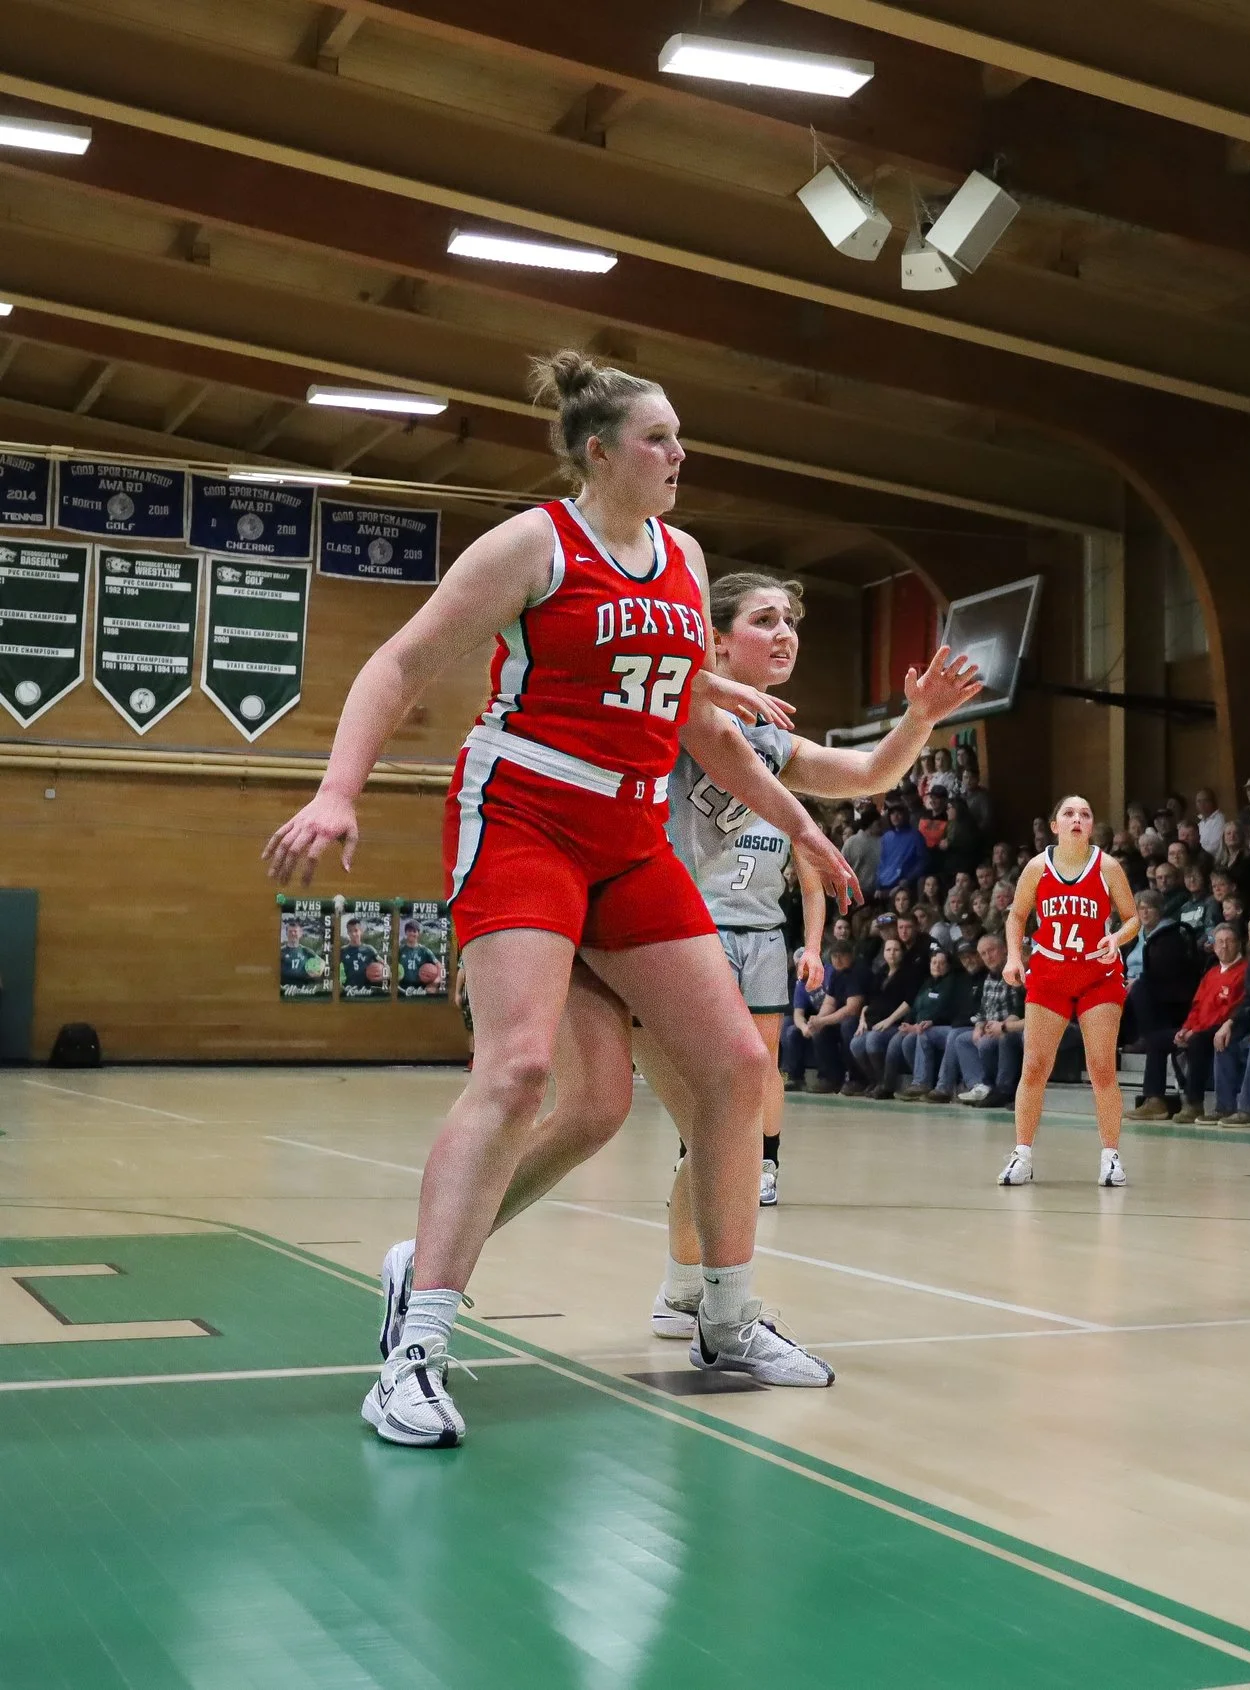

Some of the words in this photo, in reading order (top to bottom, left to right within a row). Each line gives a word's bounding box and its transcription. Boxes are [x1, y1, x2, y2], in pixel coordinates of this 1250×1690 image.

[71, 464, 95, 477] GOOD
[97, 464, 174, 489] SPORTSMANSHIP
[98, 479, 144, 493] AWARD
[6, 489, 37, 501] 2014
[203, 486, 227, 497] GOOD
[229, 485, 302, 508] SPORTSMANSHIP
[72, 497, 102, 511] NORTH
[230, 499, 274, 513] AWARD
[2, 511, 44, 523] TENNIS
[332, 510, 355, 523] GOOD
[356, 511, 427, 534] SPORTSMANSHIP
[105, 522, 136, 532] GOLF
[357, 524, 400, 538] AWARD
[225, 540, 275, 552] CHEERING
[326, 542, 353, 555] CLASS
[354, 546, 361, 556] D
[20, 556, 60, 568] BASEBALL
[22, 569, 61, 580] CHAMPIONS
[134, 566, 181, 579] WRESTLING
[358, 563, 404, 576] CHEERING
[137, 580, 174, 590] CHAMPIONS
[245, 575, 264, 586] GOLF
[247, 589, 283, 599] CHAMPIONS
[29, 612, 68, 623] CHAMPIONS
[143, 620, 181, 631] CHAMPIONS
[595, 597, 706, 651] DEXTER
[21, 646, 61, 657] CHAMPIONS
[136, 655, 174, 666] CHAMPIONS
[601, 655, 693, 721] 32
[731, 854, 756, 890] 3
[296, 900, 321, 911] PVHS
[355, 901, 380, 911] PVHS
[413, 903, 438, 913] PVHS
[1042, 895, 1098, 919] DEXTER
[1051, 921, 1085, 953] 14
[323, 915, 331, 990] SENIOR
[382, 916, 390, 990] SENIOR
[439, 917, 447, 991] SENIOR
[291, 959, 300, 969] 17
[353, 960, 359, 971] 5
[284, 984, 318, 996] Michael
